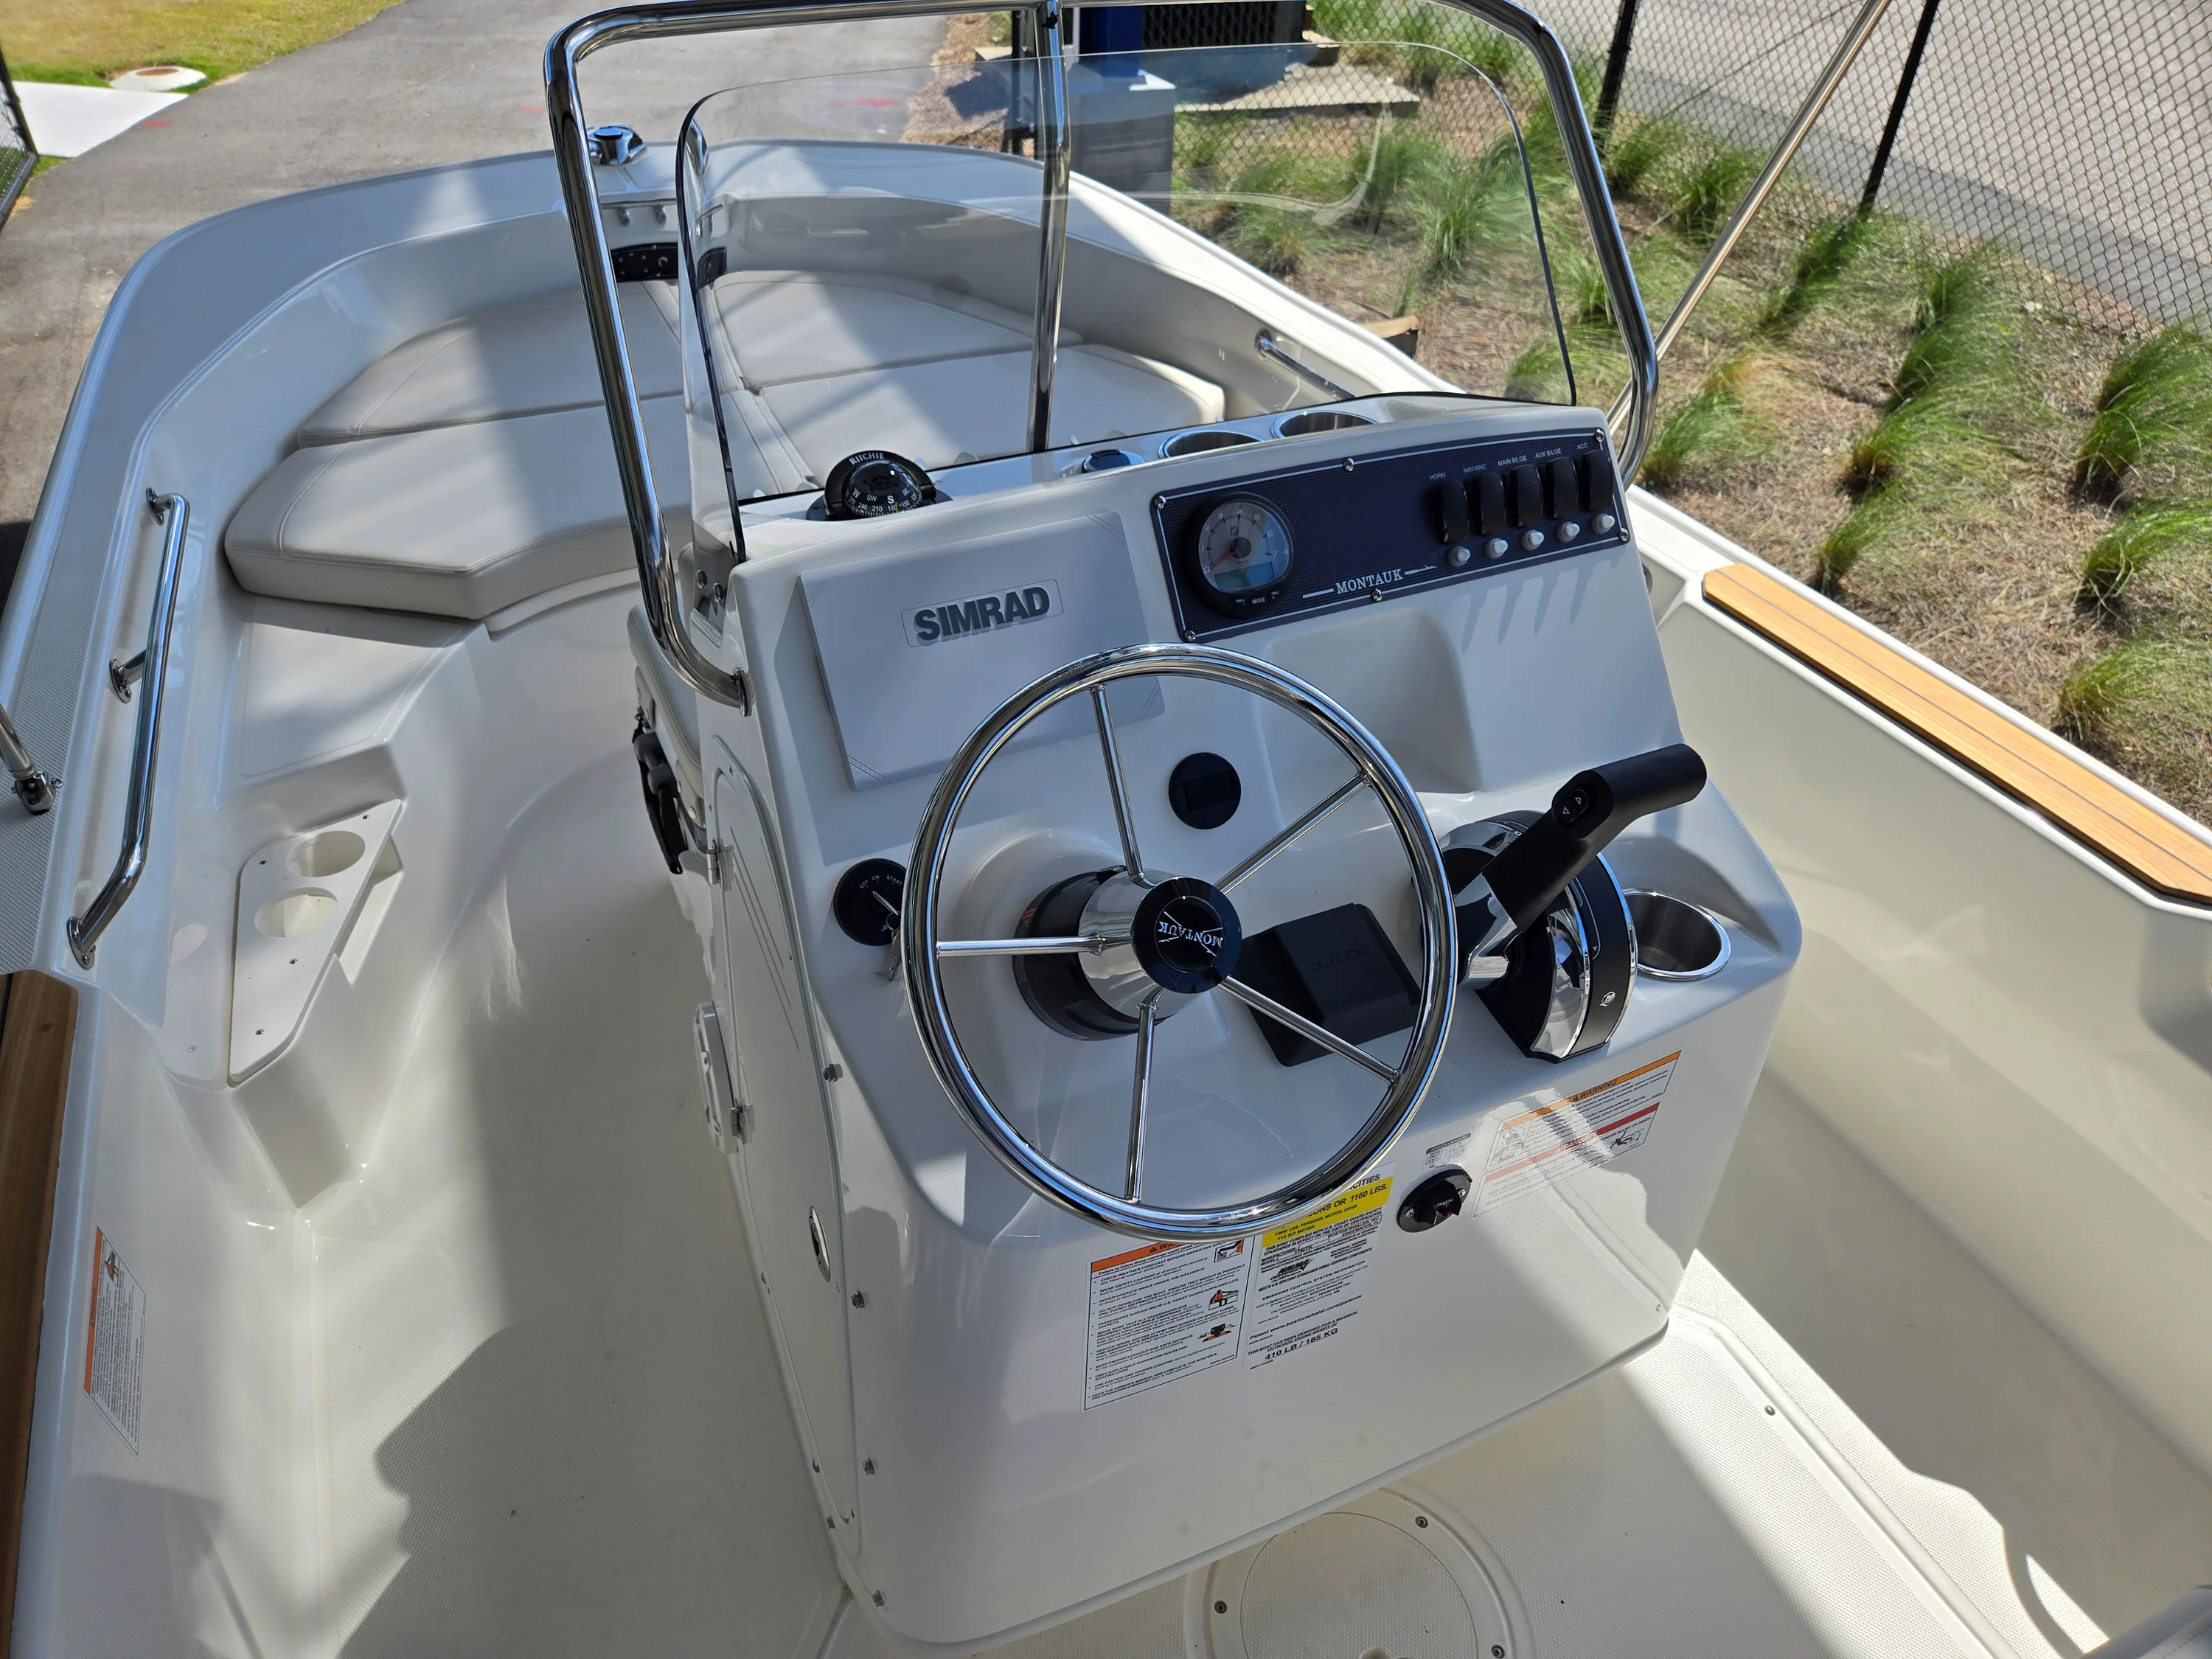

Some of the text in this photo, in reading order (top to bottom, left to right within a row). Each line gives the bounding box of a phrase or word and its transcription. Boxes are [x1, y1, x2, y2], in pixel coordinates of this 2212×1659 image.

[1535, 448, 1562, 459] AUX BILGE
[1577, 442, 1588, 451] ACC
[849, 452, 885, 465] RITCHIE
[1498, 455, 1528, 467] MAIN BILGE
[1429, 472, 1446, 481] HORN
[852, 488, 861, 498] W
[887, 495, 894, 504] S
[858, 502, 868, 510] 240
[902, 500, 911, 508] 150
[1335, 568, 1404, 594] MONTAUK
[914, 586, 1051, 642] SIMRAD
[859, 879, 869, 889] OFF
[886, 874, 903, 886] START
[1158, 921, 1224, 948] MONTAUK
[1311, 946, 1371, 970] JL AUDIO
[1579, 1079, 1618, 1099] WARNING
[1350, 1173, 1381, 1190] CITIES
[1333, 1182, 1388, 1208] OR 1160 LBS.
[1436, 1197, 1454, 1207] RUN
[1264, 1243, 1290, 1256] STANDARDS
[1350, 1210, 1382, 1225] CERTIFICATION
[1262, 1288, 1288, 1301] EMISSIONS
[1289, 1279, 1312, 1290] CONTROL
[1333, 1259, 1365, 1274] INFORMATION
[1147, 1307, 1177, 1319] PASSENGERS
[1270, 1293, 1362, 1332] www.bostonwhaler.com/patents
[1297, 1324, 1321, 1336] DESIGNED
[1336, 1310, 1357, 1321] MAXIMUM
[1265, 1349, 1281, 1361] 410
[1284, 1343, 1297, 1353] LB
[1305, 1333, 1321, 1345] 185
[1324, 1326, 1338, 1338] KG
[1267, 1339, 1293, 1352] OUTBOARD
